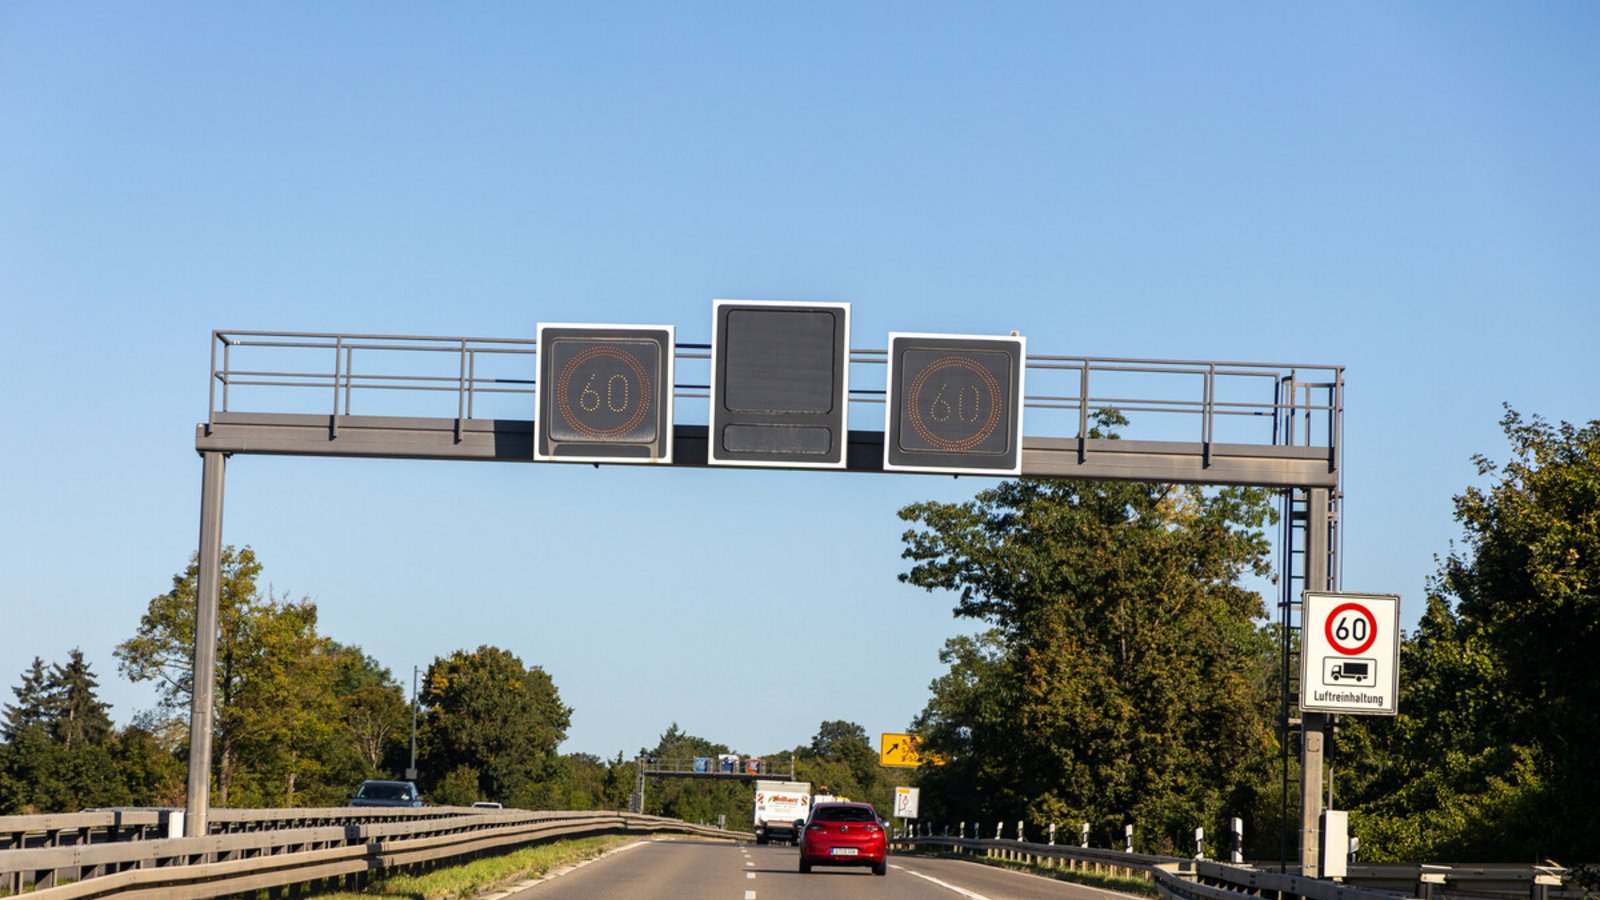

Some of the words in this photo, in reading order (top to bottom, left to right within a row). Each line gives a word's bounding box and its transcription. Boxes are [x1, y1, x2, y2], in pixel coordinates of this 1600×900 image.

[580, 373, 628, 412] 60
[930, 383, 980, 422] 60
[1336, 617, 1366, 641] 60
[1314, 690, 1383, 707] Luftreinhaltung
